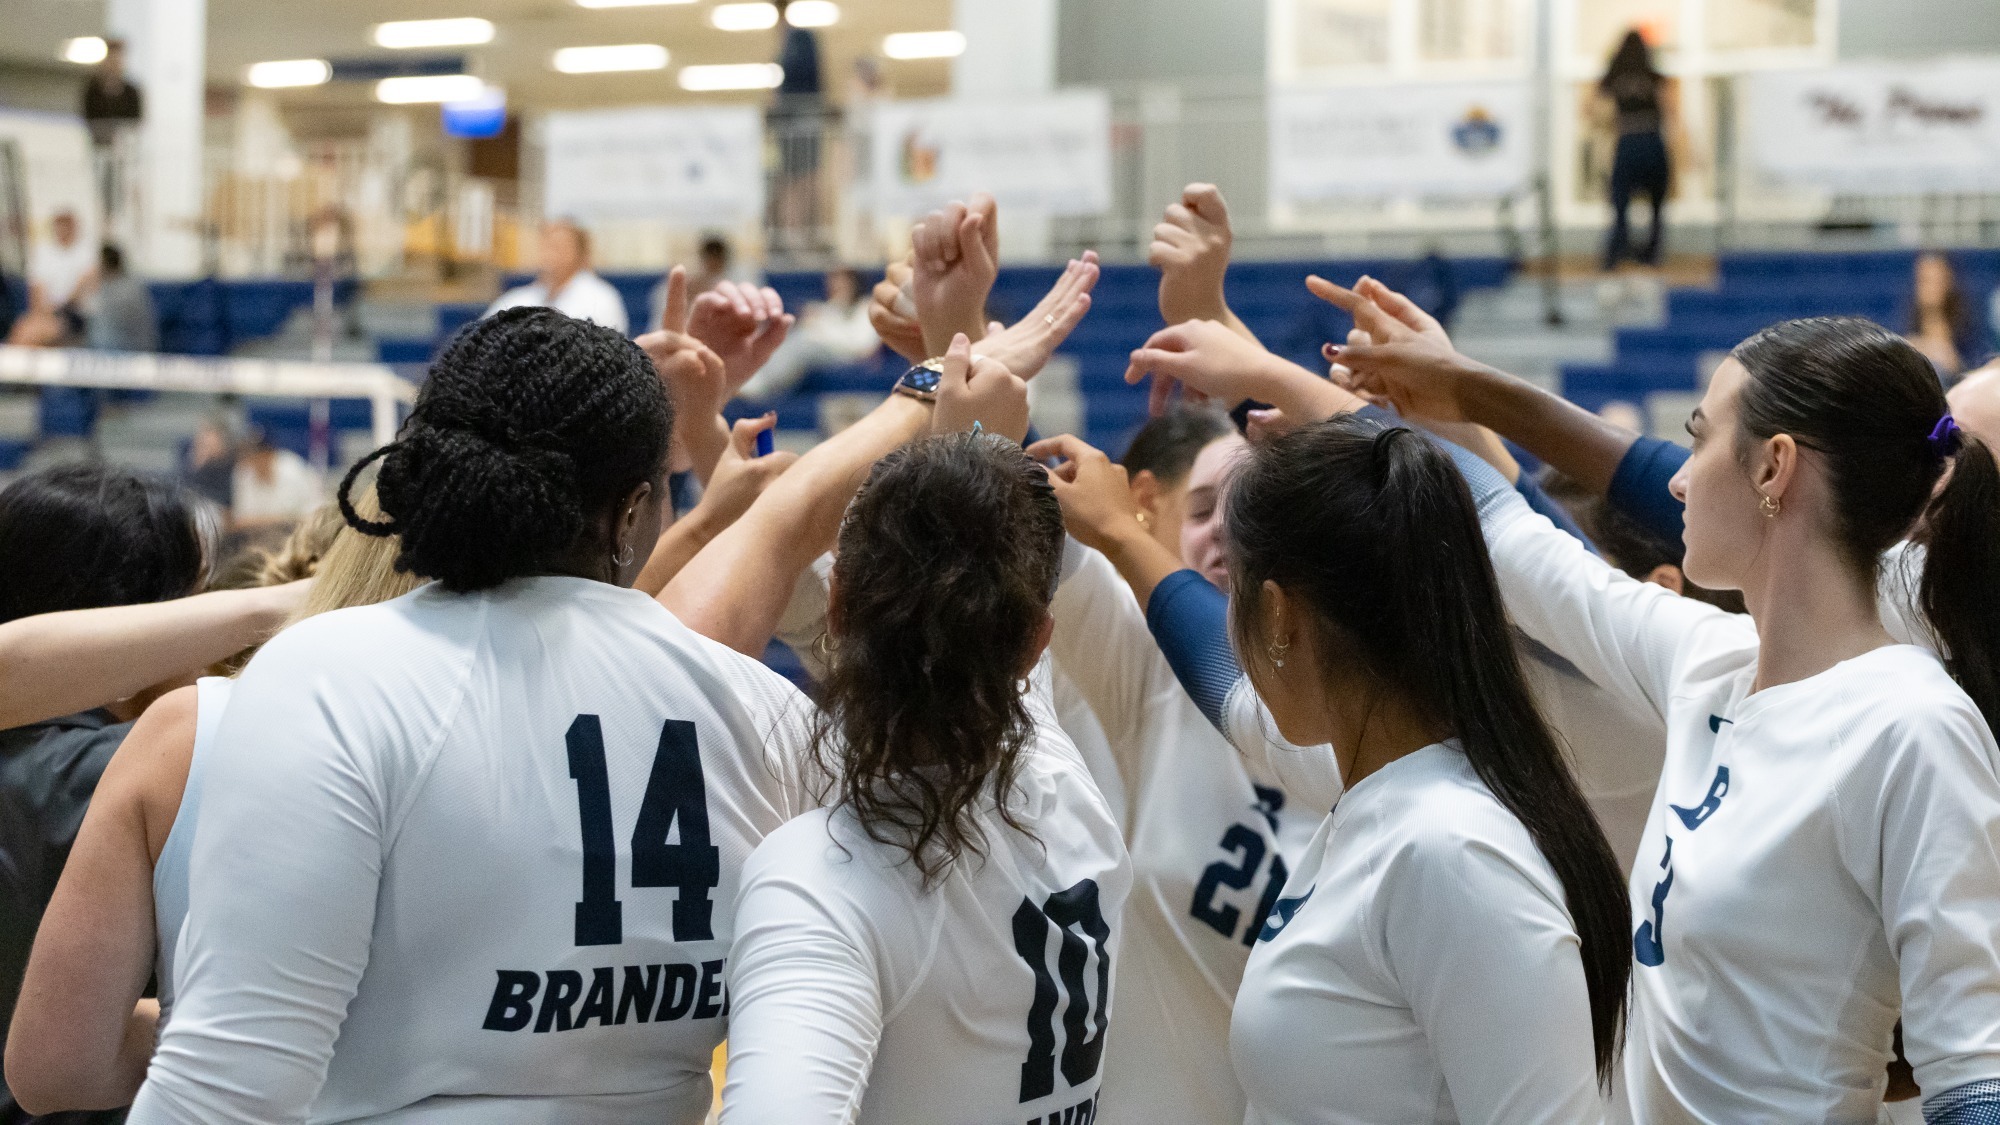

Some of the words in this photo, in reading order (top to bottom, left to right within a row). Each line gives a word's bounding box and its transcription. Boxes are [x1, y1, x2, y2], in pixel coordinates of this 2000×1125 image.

[565, 714, 719, 946] 14
[1190, 822, 1288, 948] 21
[1012, 878, 1110, 1103] 10
